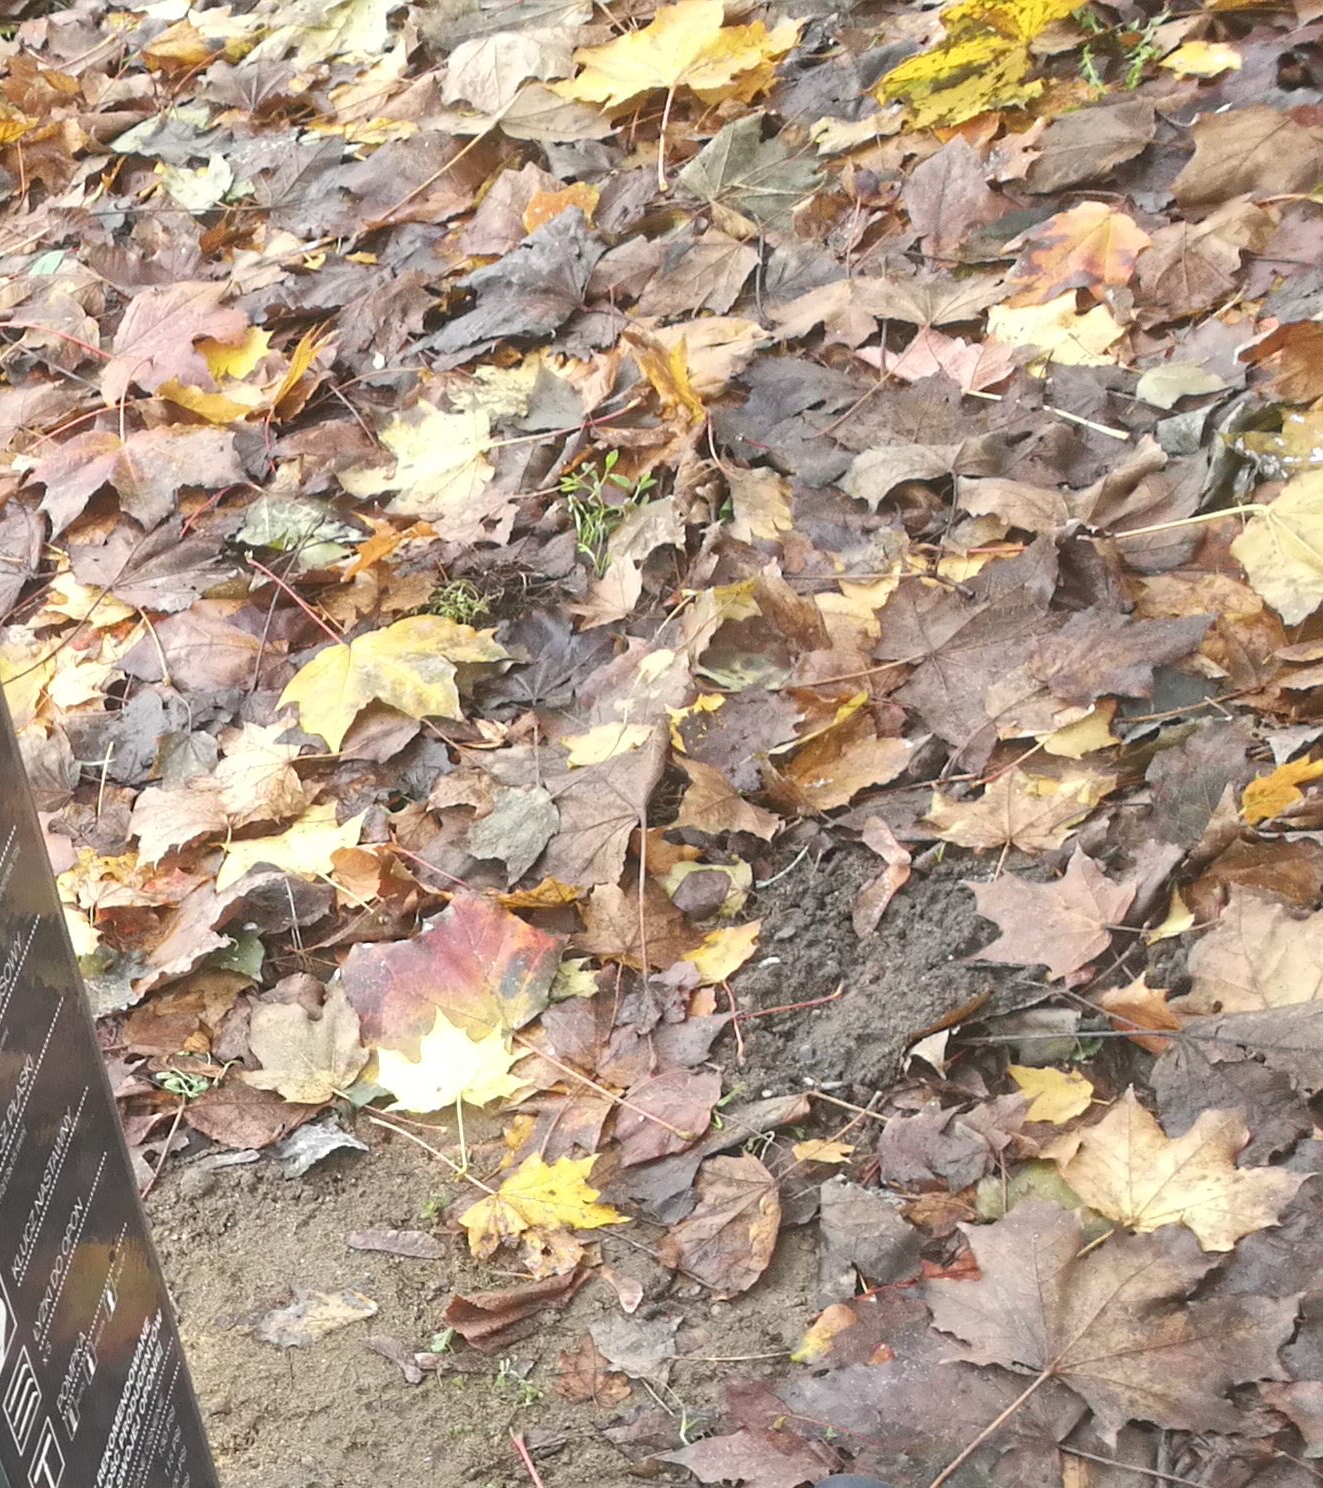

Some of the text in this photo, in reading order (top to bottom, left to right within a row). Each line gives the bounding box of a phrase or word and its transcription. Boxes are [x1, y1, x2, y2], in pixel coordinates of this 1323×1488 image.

[6, 1054, 33, 1124] PŁASKI
[11, 1107, 71, 1279] KLUCZ NASTAWNY
[49, 1254, 63, 1288] DO
[61, 1196, 82, 1255] OPON
[56, 1331, 85, 1412] POMPKA
[97, 1318, 150, 1484] REKOMENDOWANE
[116, 1309, 162, 1447] PRODUCENTÓW
[116, 1414, 140, 1488] SWOJEJ
